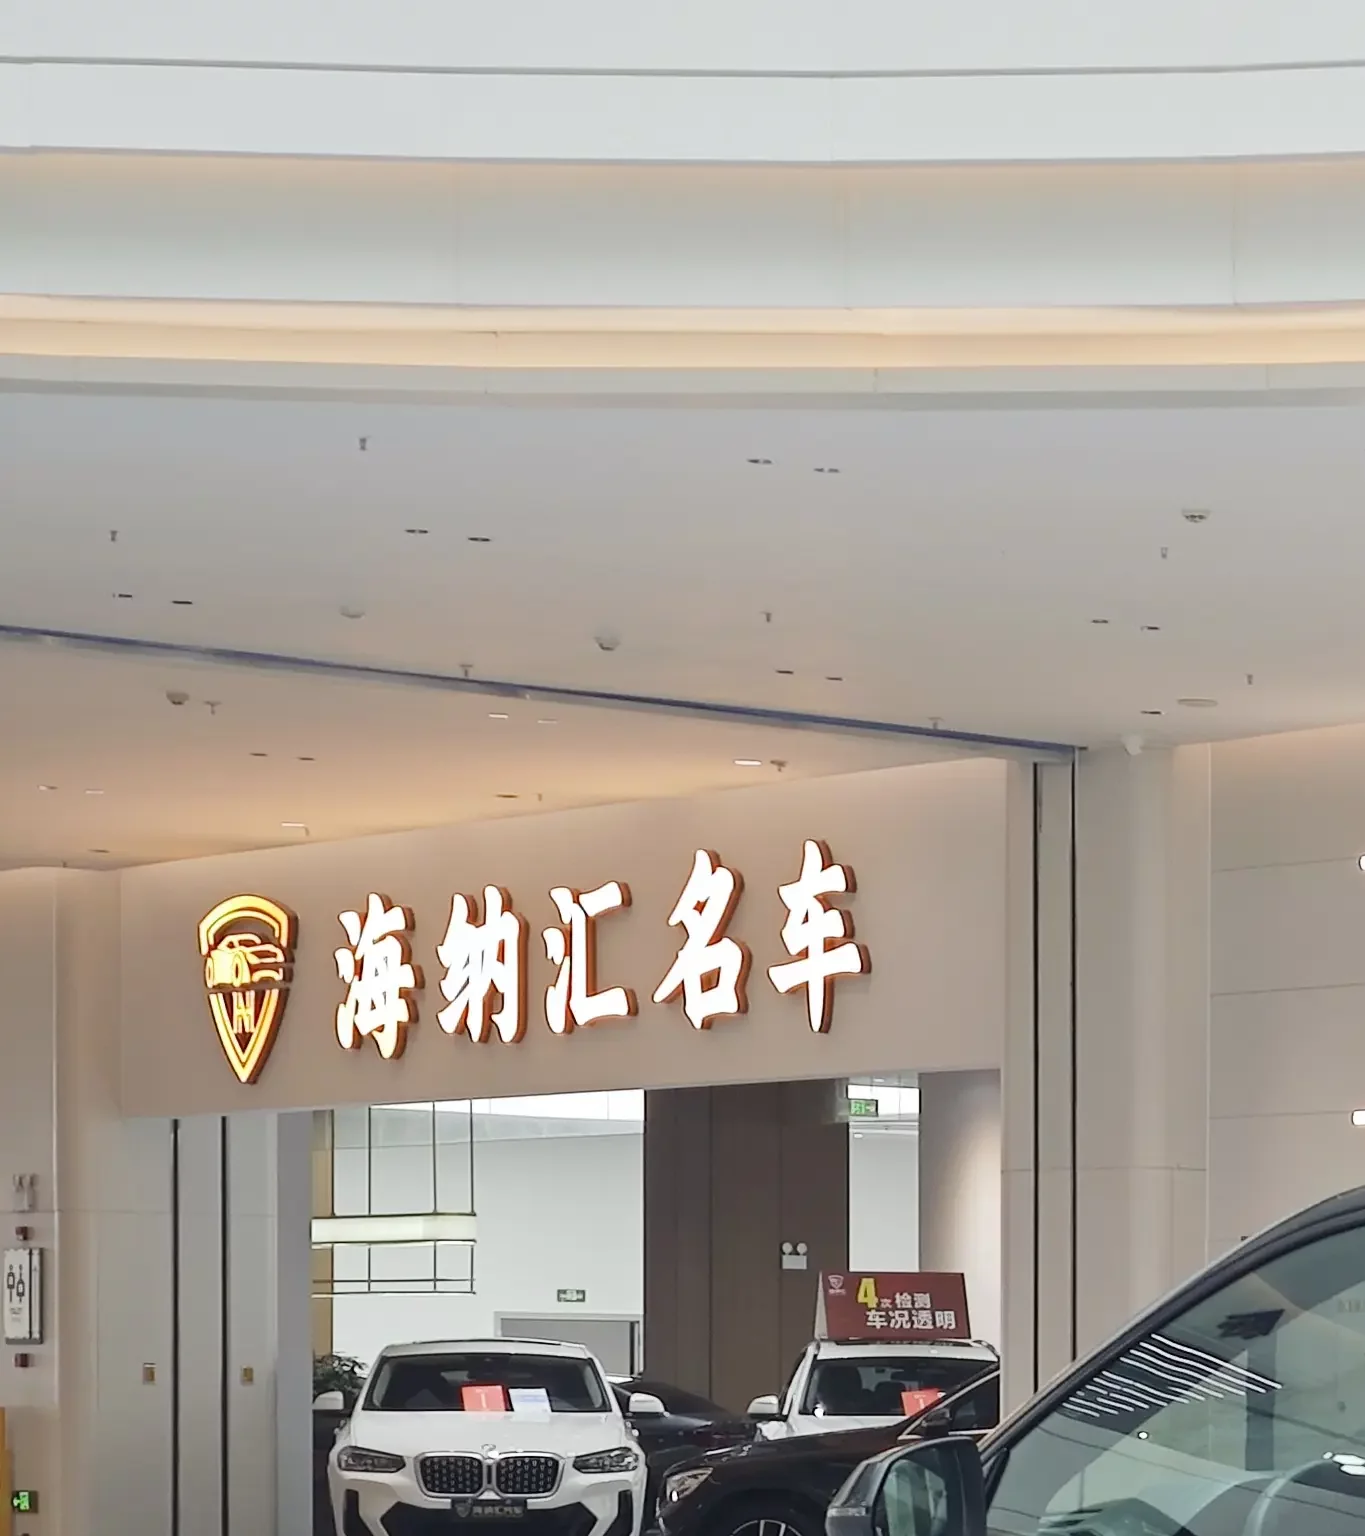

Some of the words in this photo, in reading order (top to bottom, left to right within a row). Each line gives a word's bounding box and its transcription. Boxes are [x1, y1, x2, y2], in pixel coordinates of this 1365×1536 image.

[334, 838, 872, 1059] 海纳汇名车
[857, 1277, 932, 1309] 4次检测
[866, 1309, 957, 1331] 车况透明
